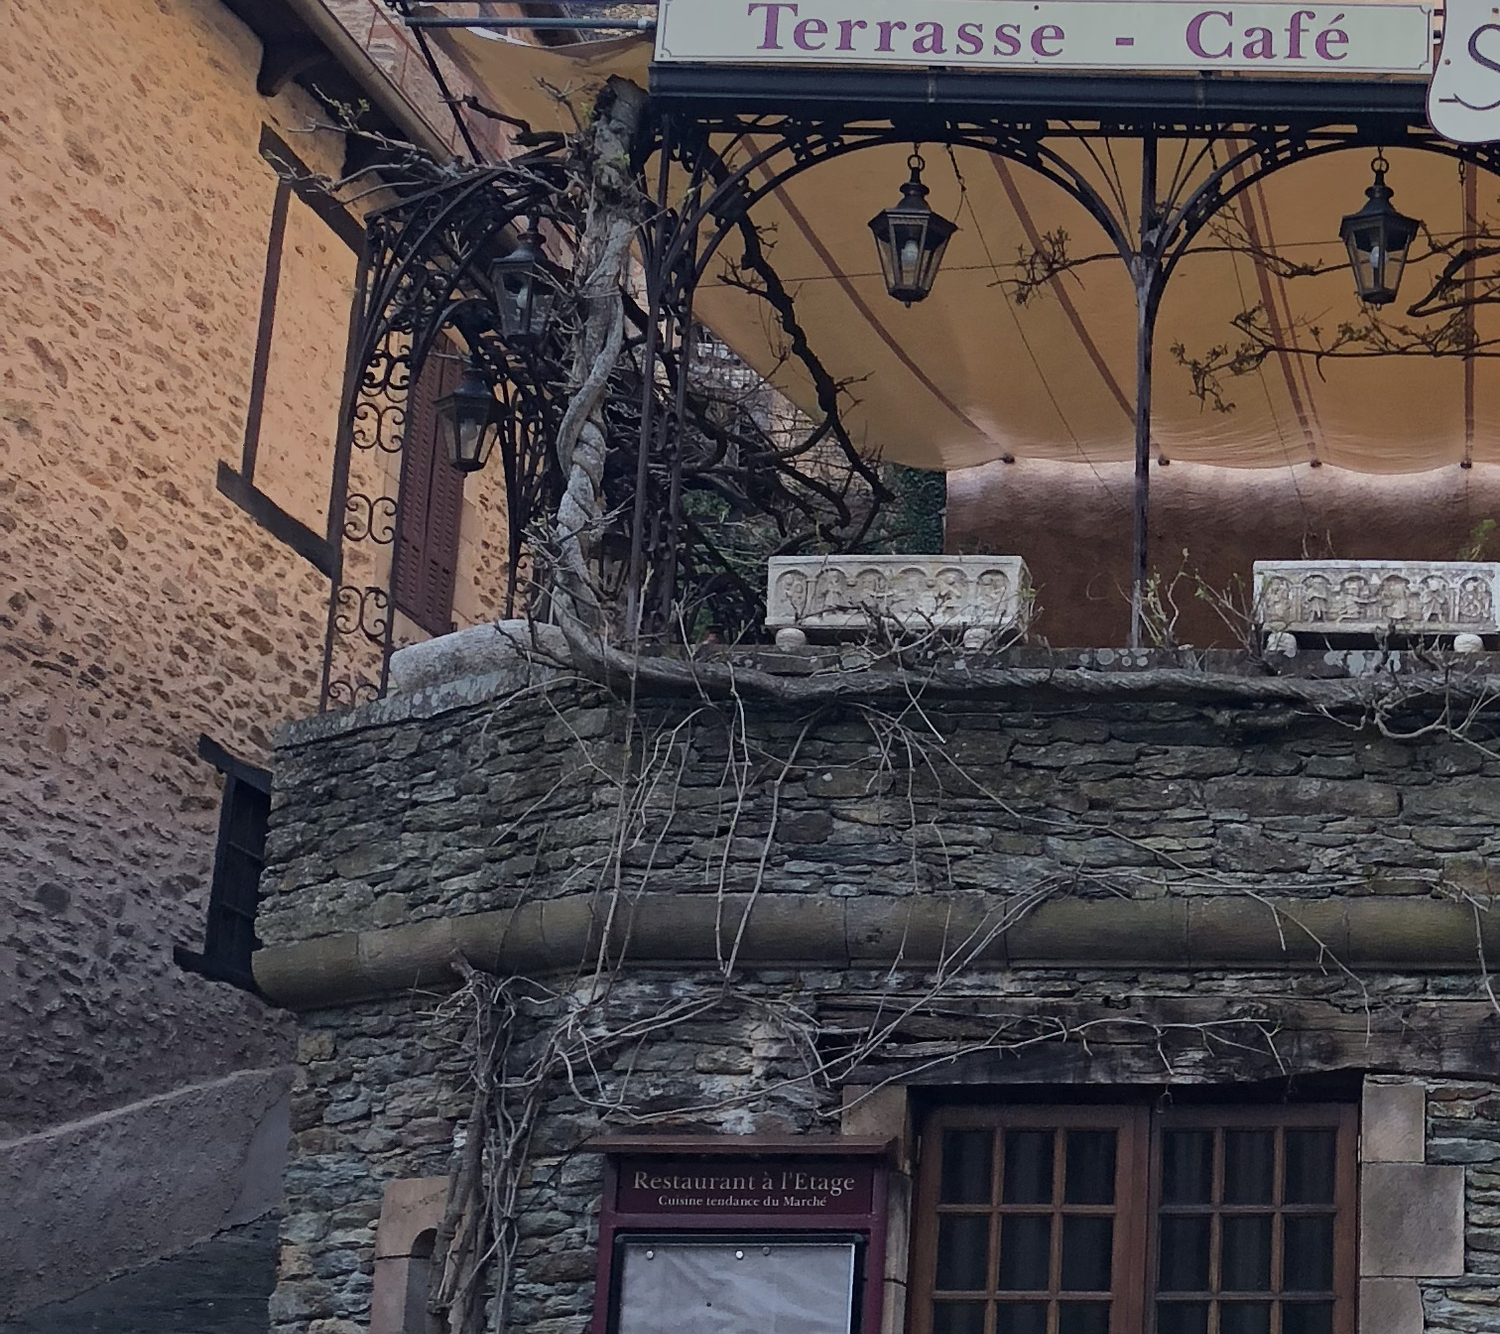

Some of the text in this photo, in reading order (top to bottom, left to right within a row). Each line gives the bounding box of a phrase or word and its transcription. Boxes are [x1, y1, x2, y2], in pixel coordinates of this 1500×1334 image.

[747, 2, 1351, 61] Terrasse - Café
[633, 1171, 855, 1197] Restaurant à l'Etage
[658, 1195, 827, 1207] Cuisine tendance du Marché
